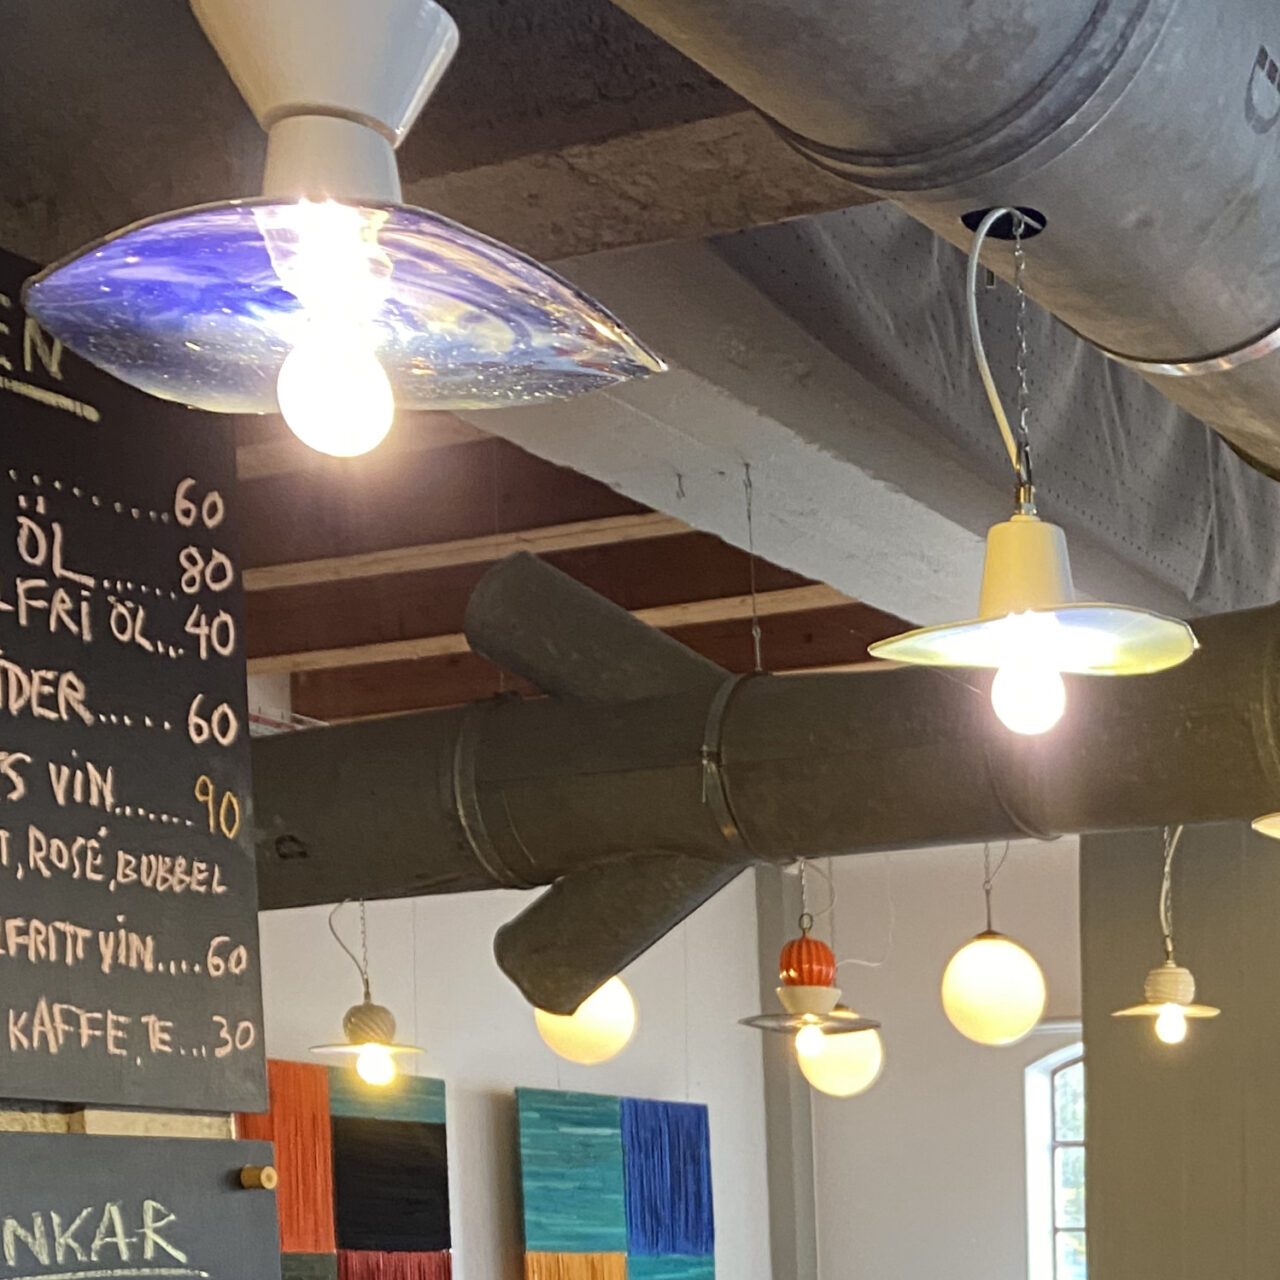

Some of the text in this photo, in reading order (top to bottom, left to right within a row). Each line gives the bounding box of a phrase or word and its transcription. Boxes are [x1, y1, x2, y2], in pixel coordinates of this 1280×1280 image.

[174, 477, 225, 529] 60
[15, 491, 234, 594] ÖL 80
[0, 574, 236, 660] FRI ÖL 40
[0, 658, 239, 747] DER 60
[194, 775, 241, 840] 90
[0, 917, 93, 966] FRITT
[206, 935, 248, 977] 60
[212, 1015, 256, 1058] 30
[3, 1199, 188, 1267] NKAR
